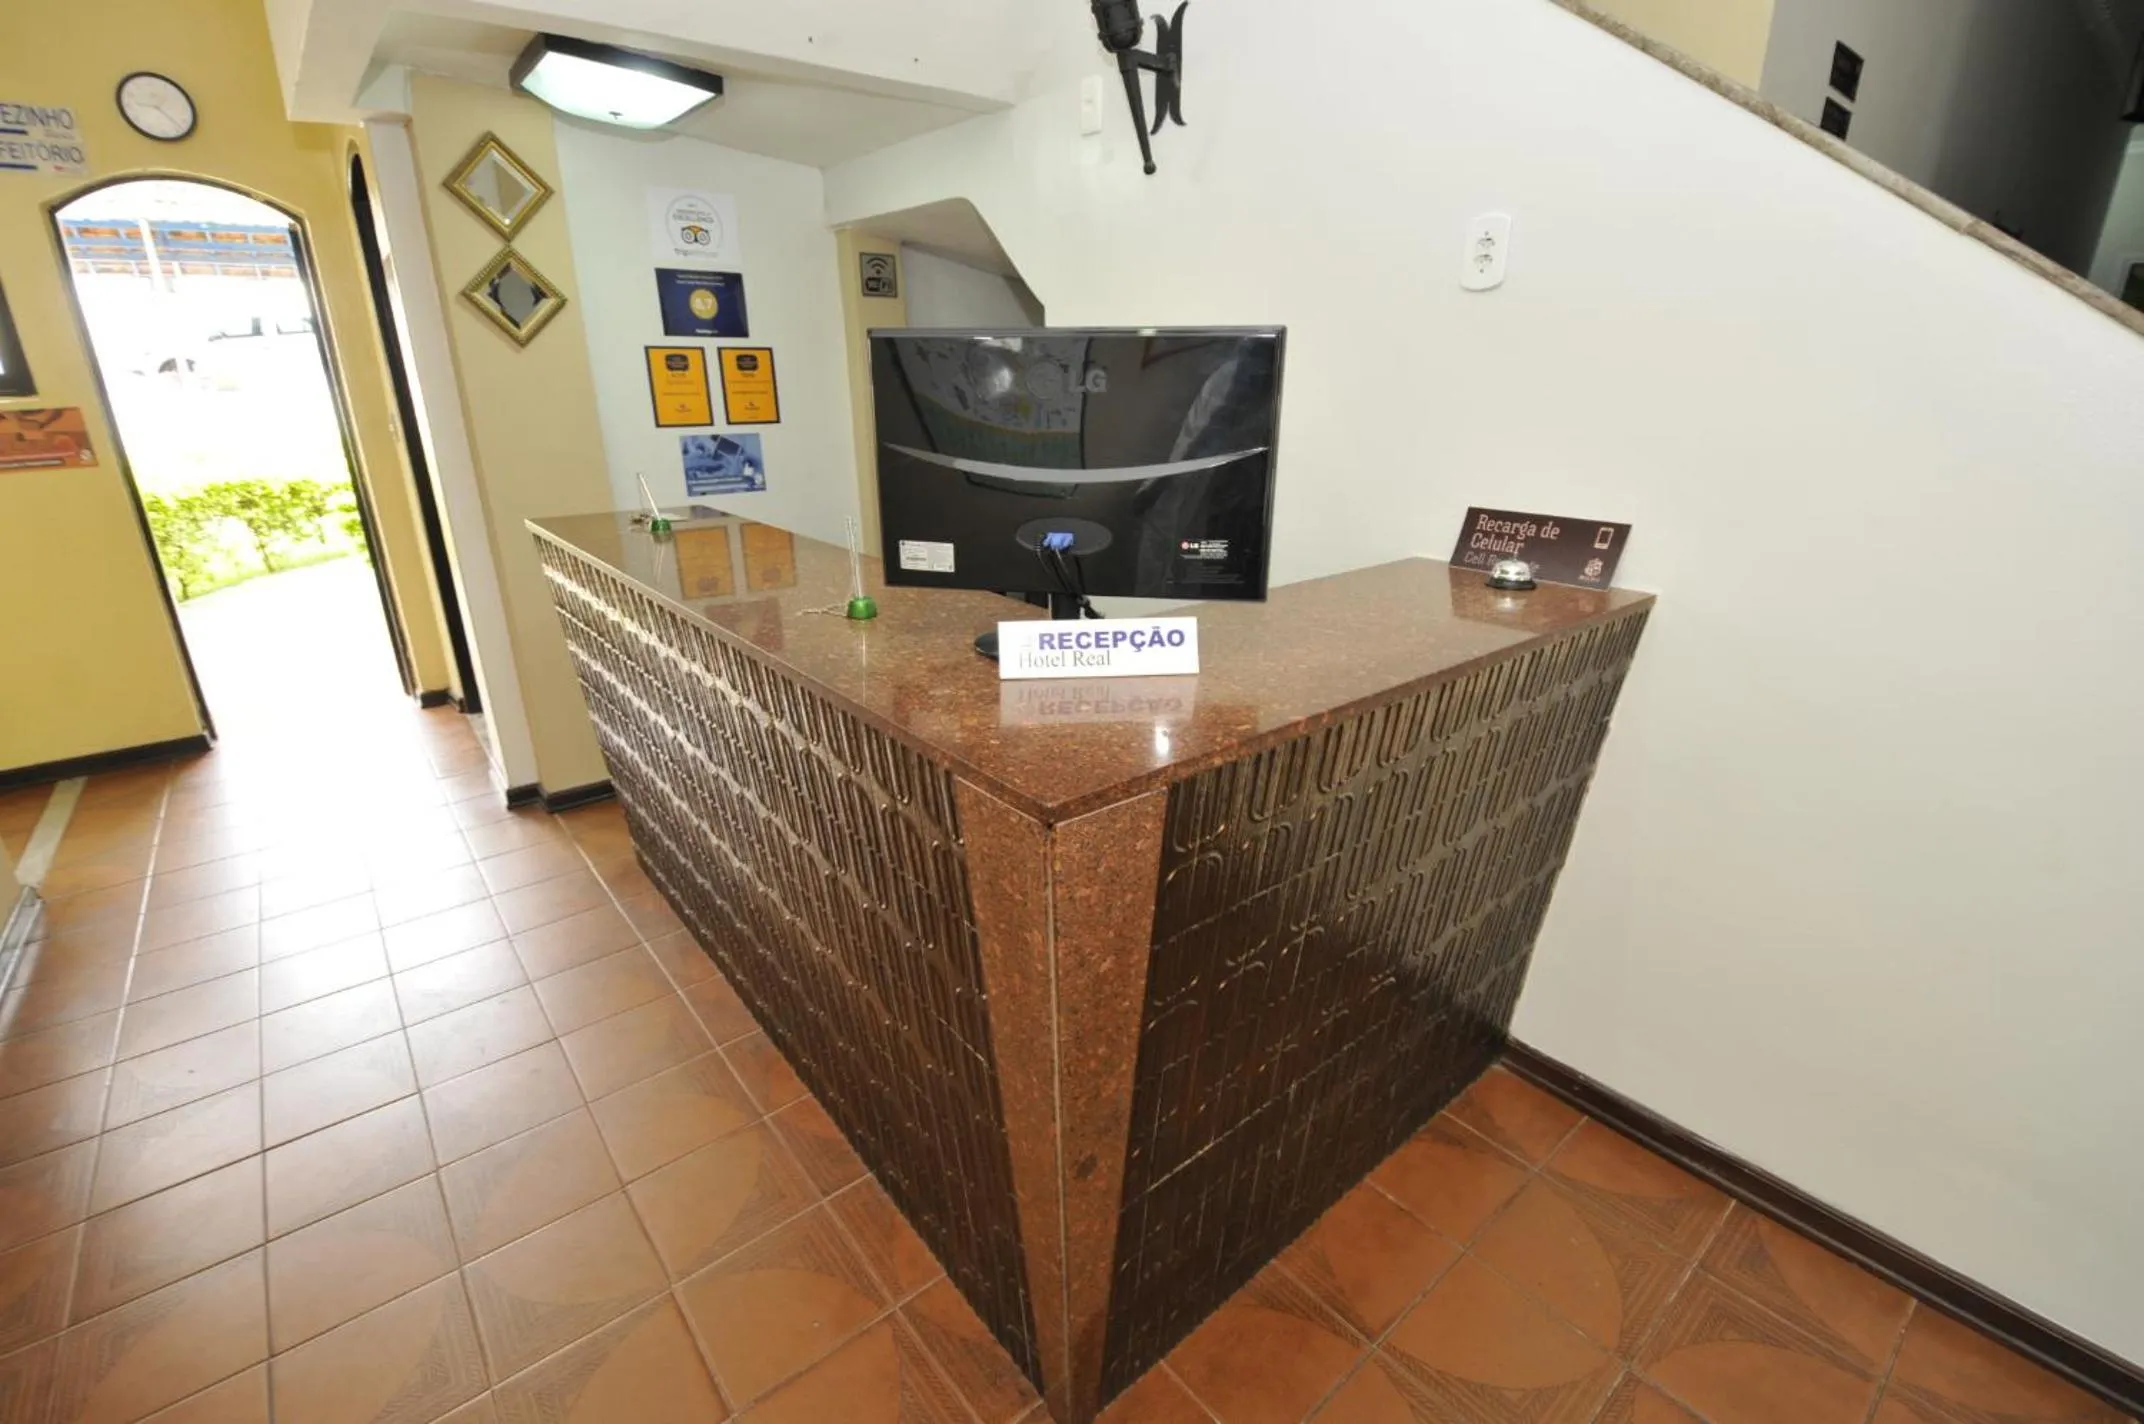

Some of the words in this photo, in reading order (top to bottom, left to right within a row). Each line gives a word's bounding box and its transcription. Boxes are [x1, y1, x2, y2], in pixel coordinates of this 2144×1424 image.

[1067, 368, 1107, 393] LG
[1476, 513, 1536, 540] Recarga
[1540, 521, 1561, 540] de
[1470, 532, 1525, 554] Celular
[1464, 551, 1486, 565] Cell
[1038, 626, 1186, 652] RECEPÇÃO
[1018, 651, 1066, 669] Hotel
[1072, 649, 1112, 667] Real
